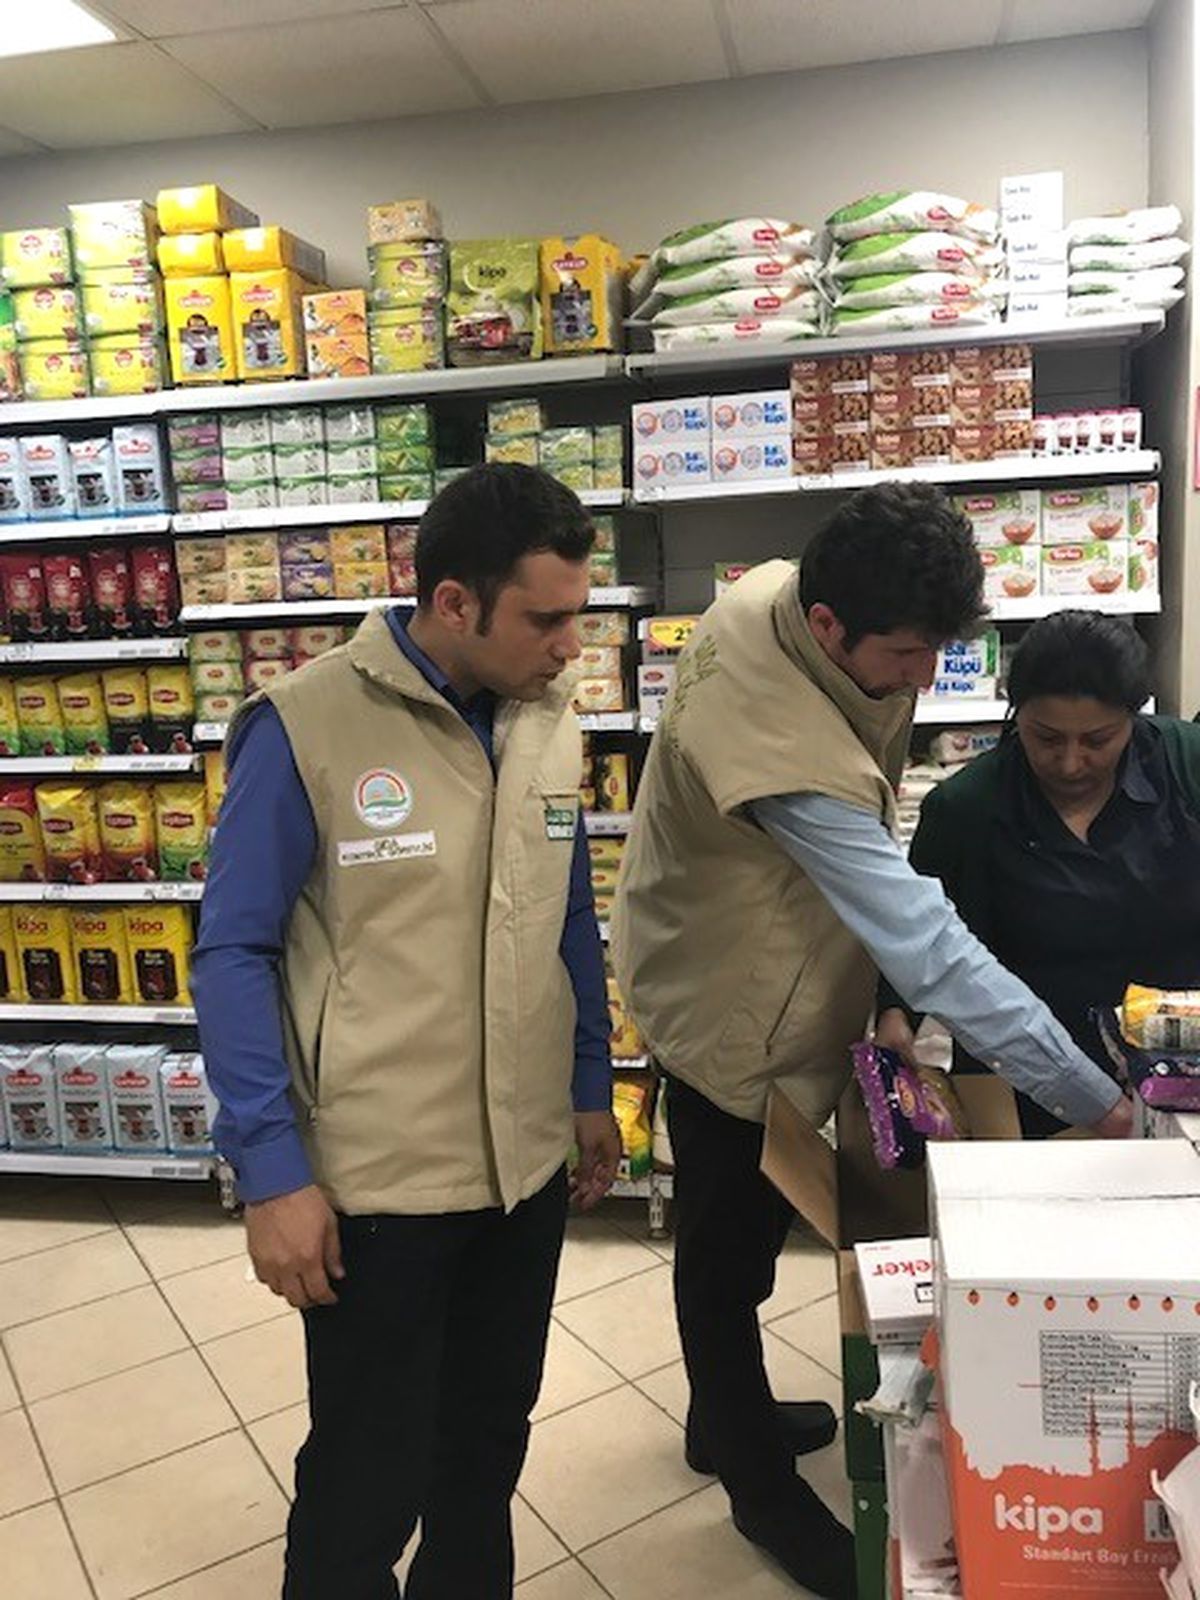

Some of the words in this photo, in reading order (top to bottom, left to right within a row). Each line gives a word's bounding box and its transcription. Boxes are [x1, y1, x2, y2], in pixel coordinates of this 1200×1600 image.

[944, 658, 982, 677] Küpü
[130, 916, 164, 935] kipa
[872, 1259, 932, 1277] eker
[994, 1492, 1104, 1541] kipa
[1023, 1545, 1093, 1563] Standart
